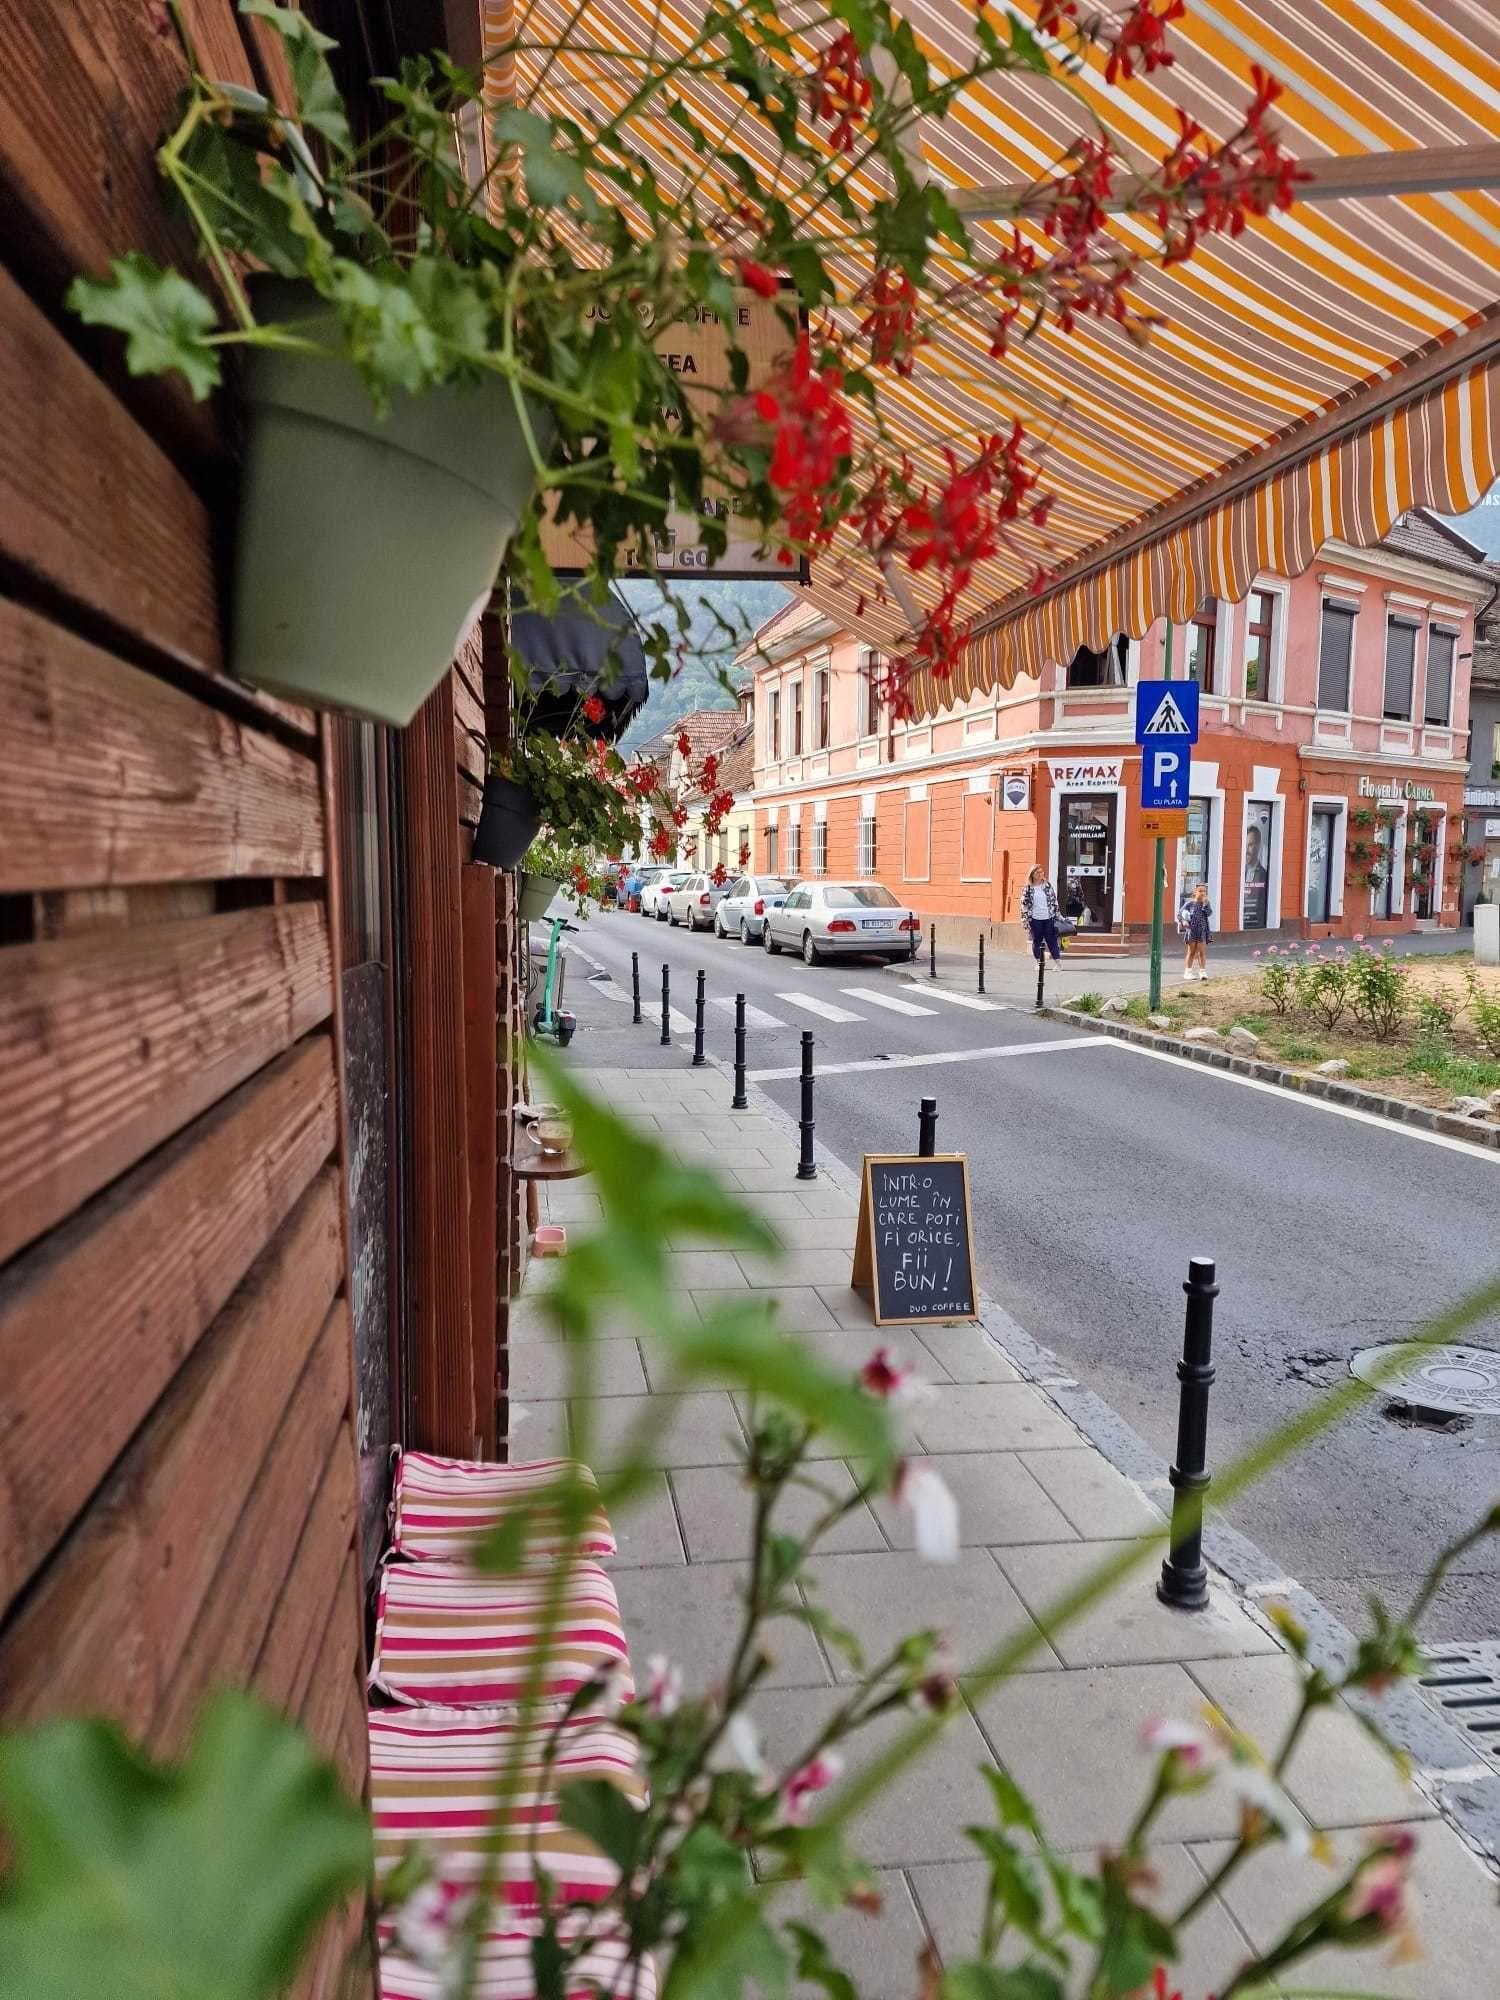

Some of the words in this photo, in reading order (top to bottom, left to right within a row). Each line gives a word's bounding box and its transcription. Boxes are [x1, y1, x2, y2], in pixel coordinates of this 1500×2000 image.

[679, 549, 708, 567] GO
[1054, 765, 1117, 780] RE/MAX
[1154, 751, 1179, 788] P
[879, 1195, 920, 1209] LUME
[878, 1212, 918, 1226] CARE
[910, 1304, 927, 1313] DUO
[932, 1302, 971, 1312] COFFEE
